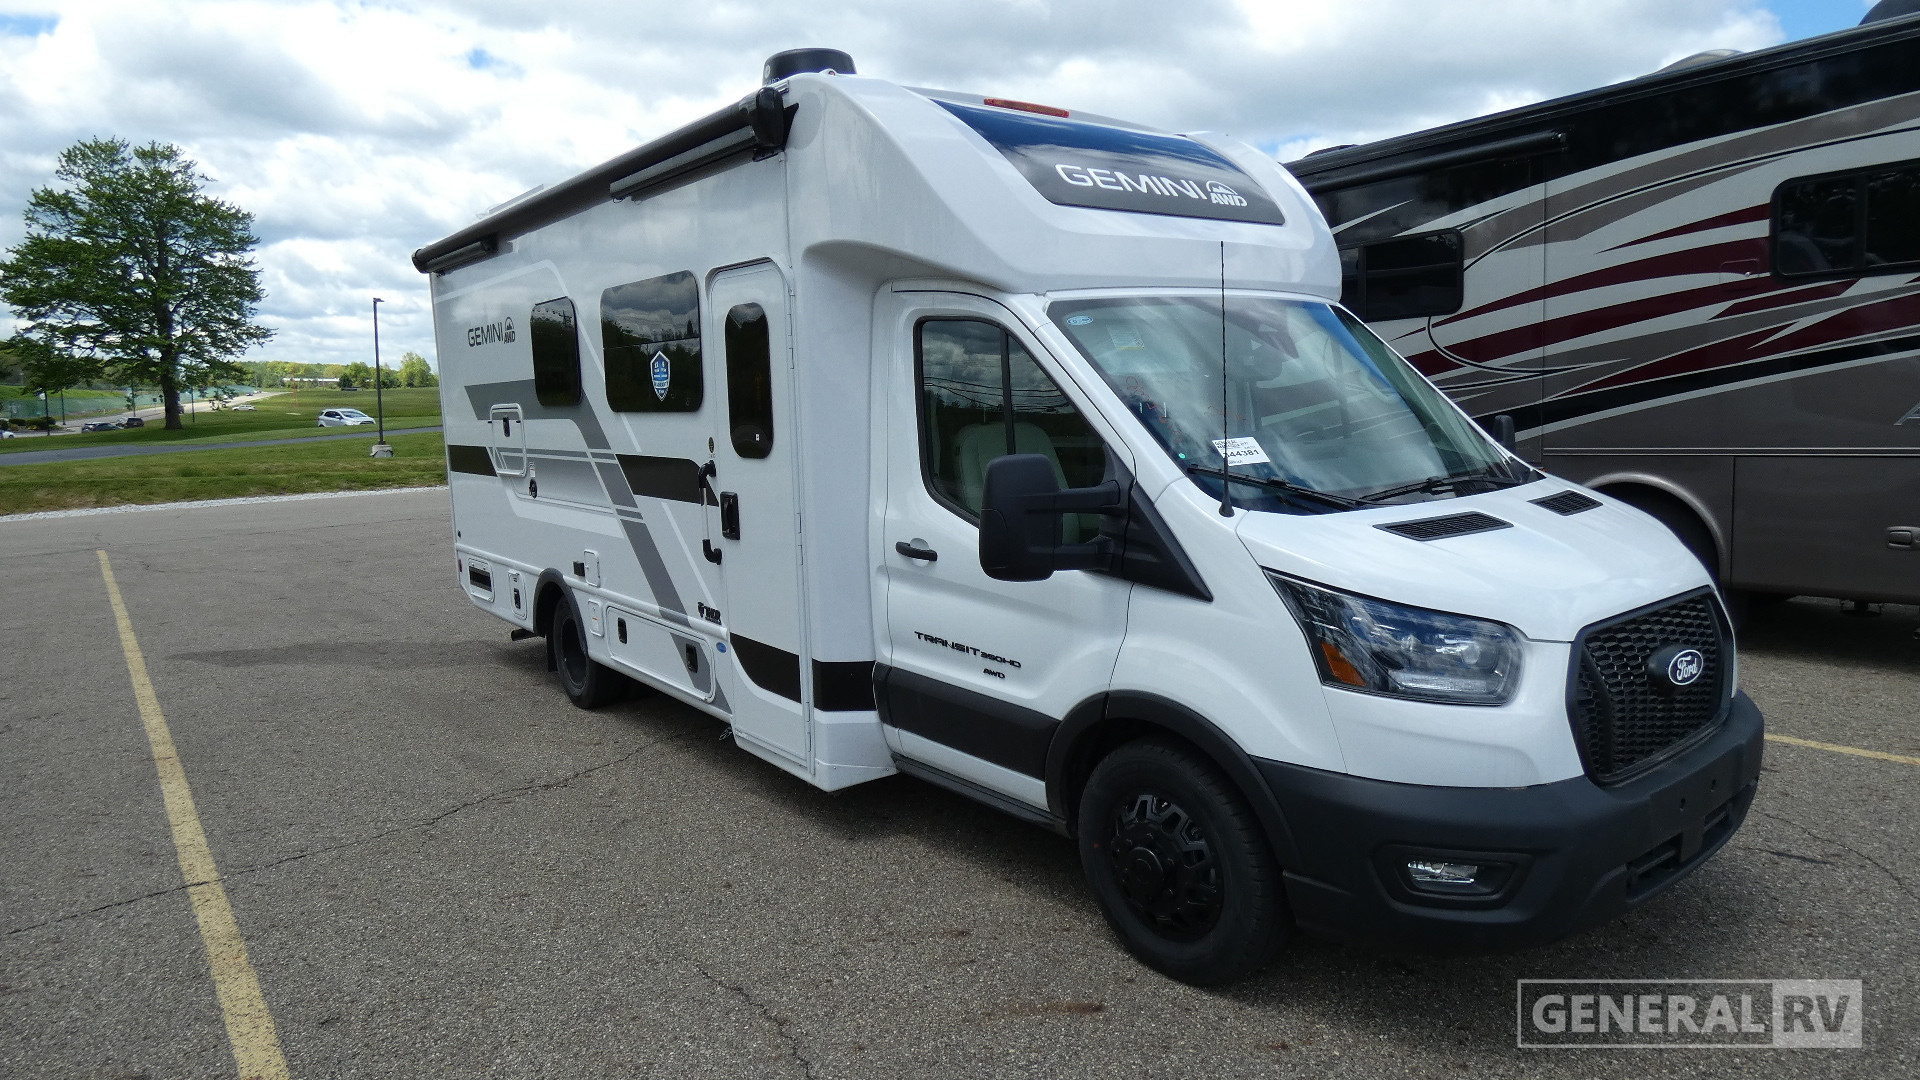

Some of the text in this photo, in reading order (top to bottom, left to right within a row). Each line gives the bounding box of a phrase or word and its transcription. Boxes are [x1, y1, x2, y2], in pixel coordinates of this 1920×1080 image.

[1054, 163, 1248, 207] GEMINI AWD
[467, 321, 503, 348] GEMINI
[914, 630, 980, 656] TRANSIT
[983, 668, 1006, 679] AWD
[1676, 655, 1698, 681] Ford
